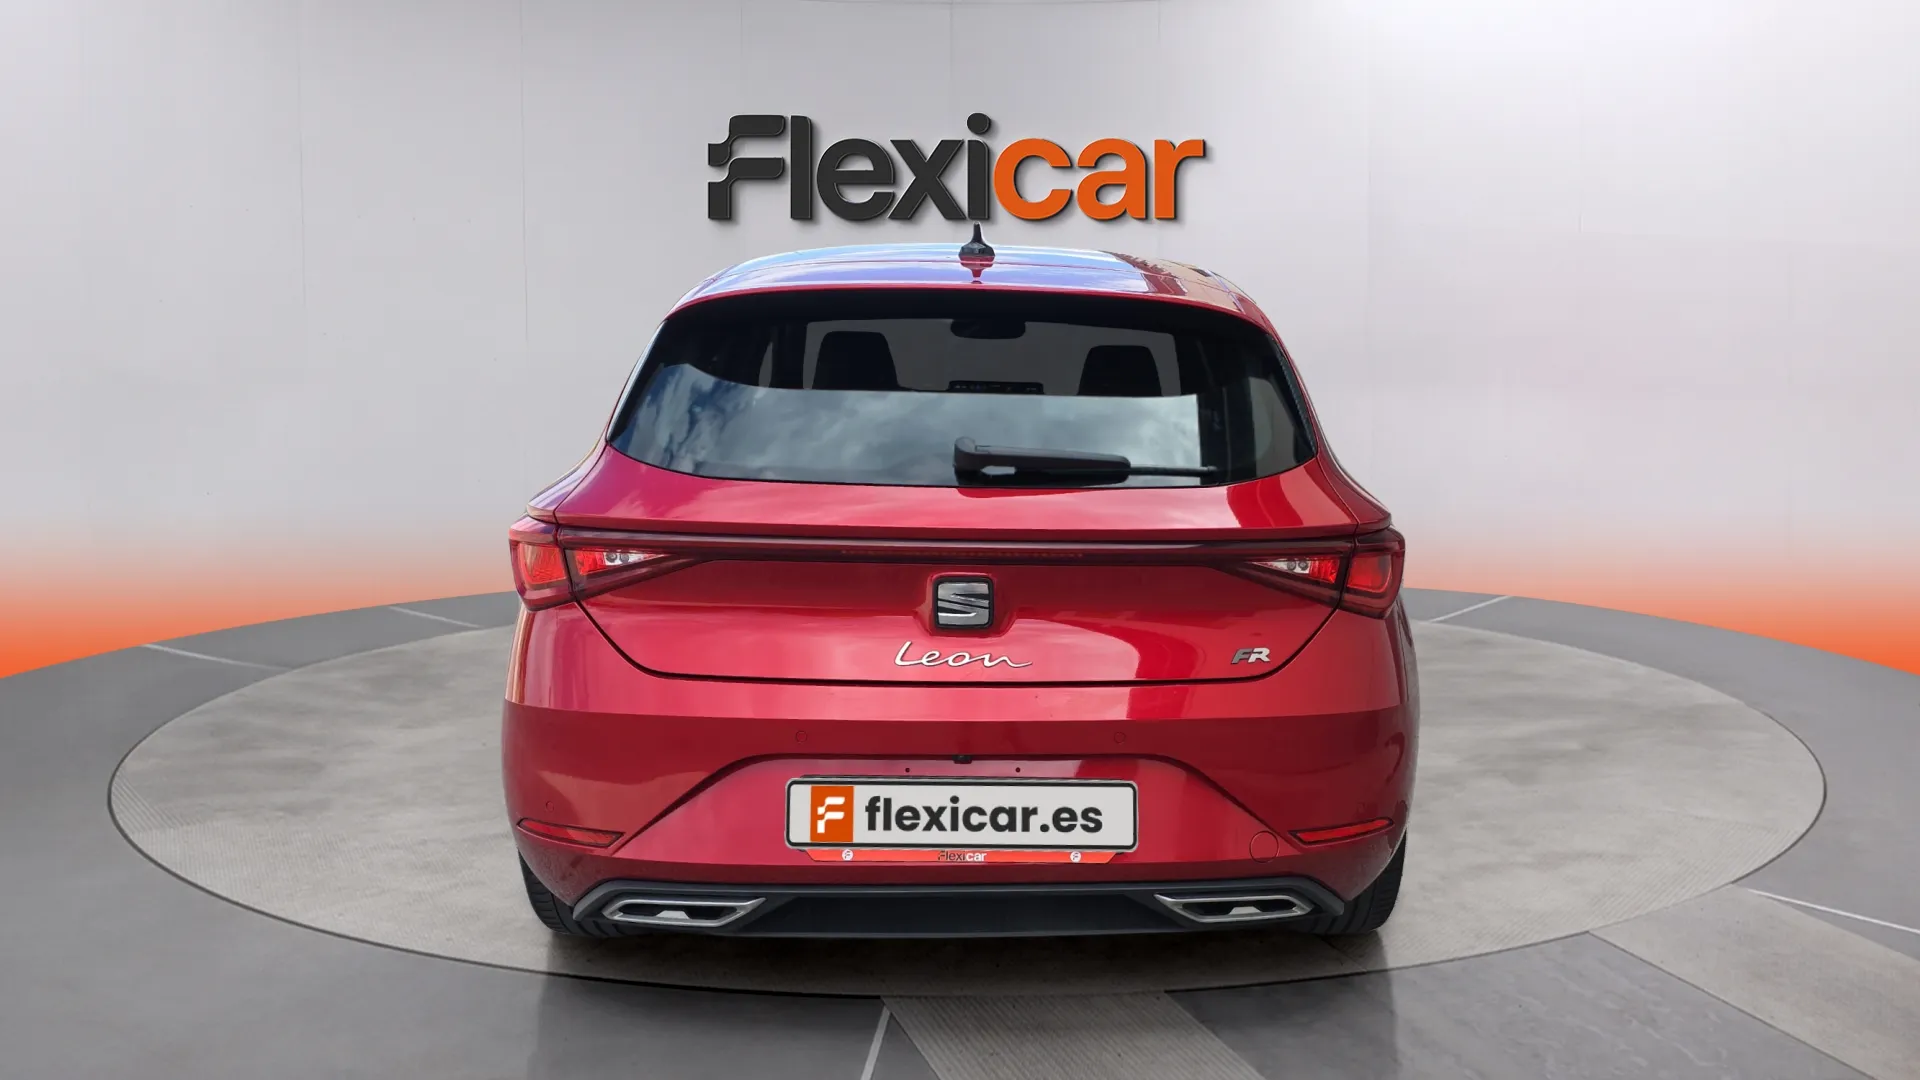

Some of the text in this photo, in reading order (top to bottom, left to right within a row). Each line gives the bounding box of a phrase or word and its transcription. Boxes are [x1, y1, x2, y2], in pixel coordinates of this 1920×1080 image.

[708, 112, 1205, 219] Flexicar
[894, 641, 1032, 667] Leon
[1231, 647, 1271, 664] FR
[865, 795, 1103, 833] flexicar.es
[938, 850, 987, 862] Flexicar
